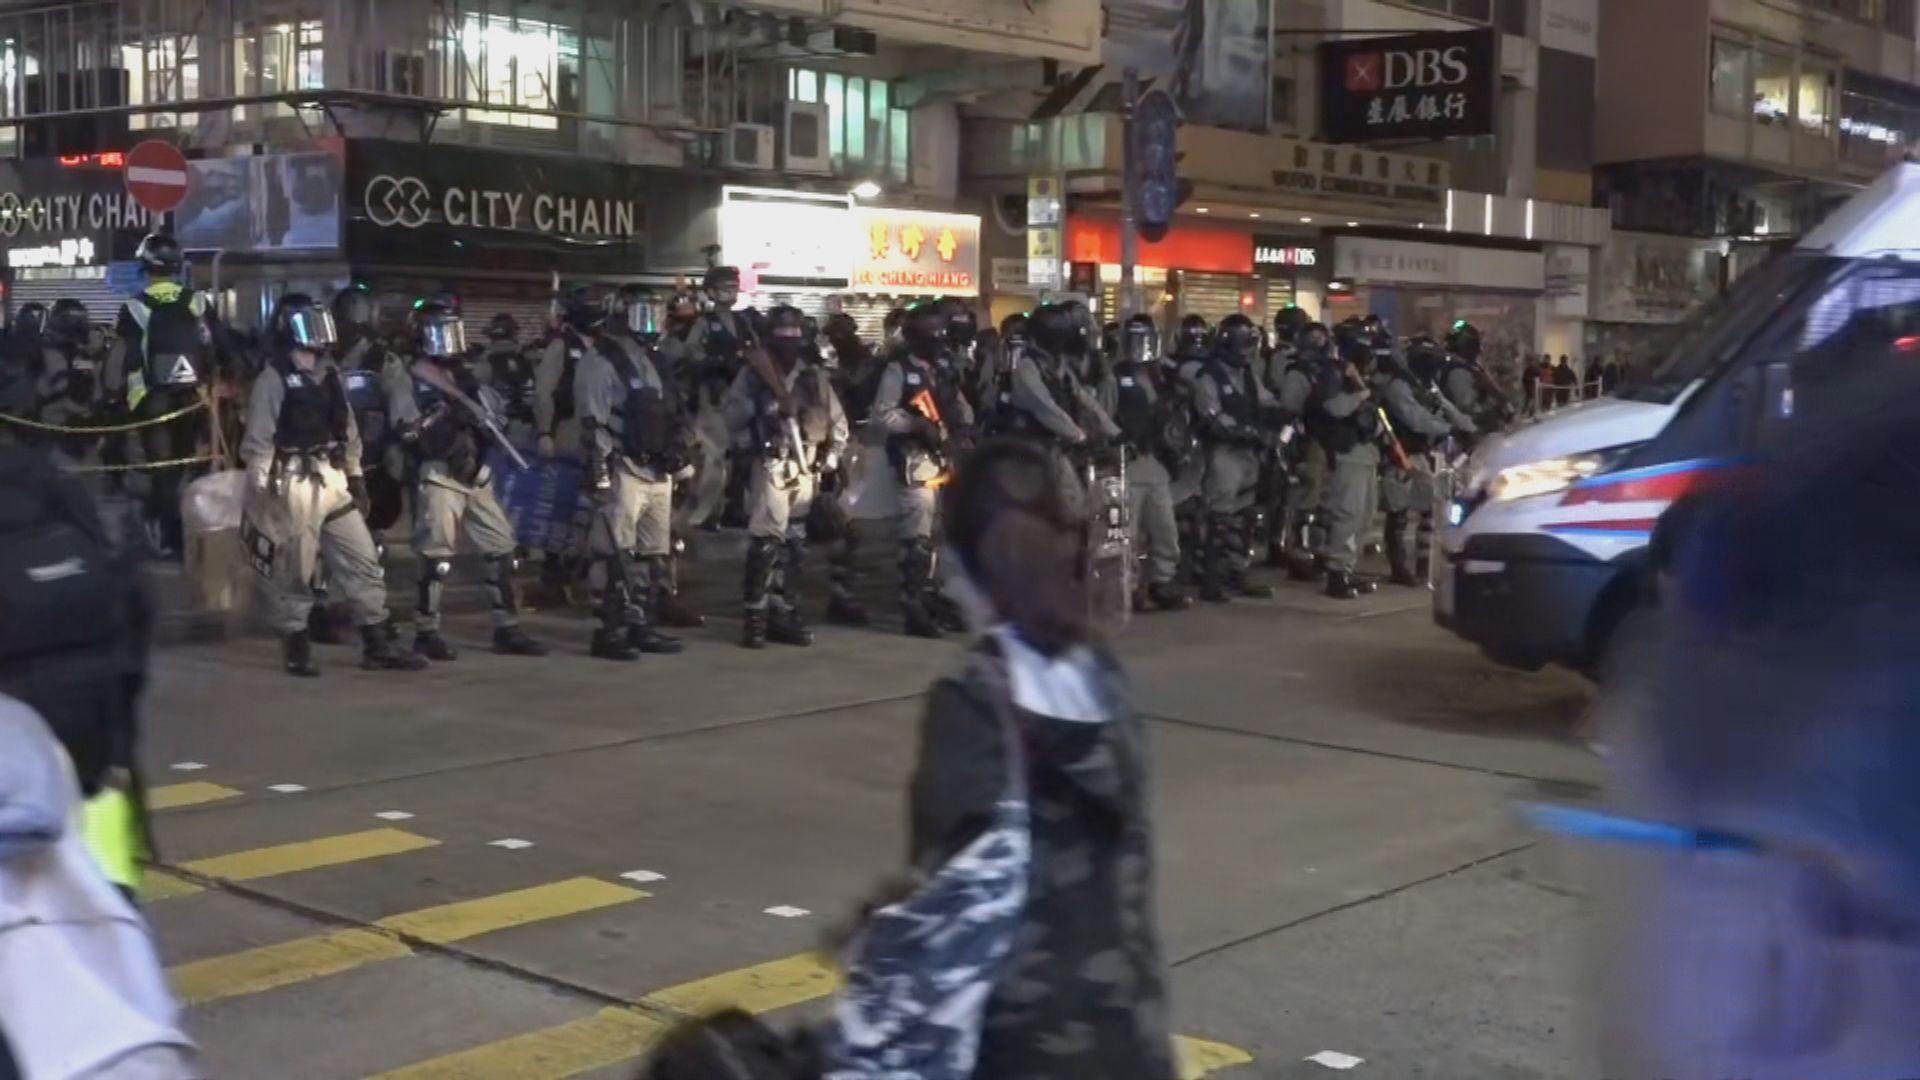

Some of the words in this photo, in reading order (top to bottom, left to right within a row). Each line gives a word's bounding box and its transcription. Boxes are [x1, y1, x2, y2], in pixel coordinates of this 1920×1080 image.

[1384, 46, 1468, 89] DBS
[1366, 92, 1467, 125] 星展銀行
[29, 194, 82, 232] CITY
[443, 187, 524, 229] CITY
[532, 194, 635, 237] CHAIN
